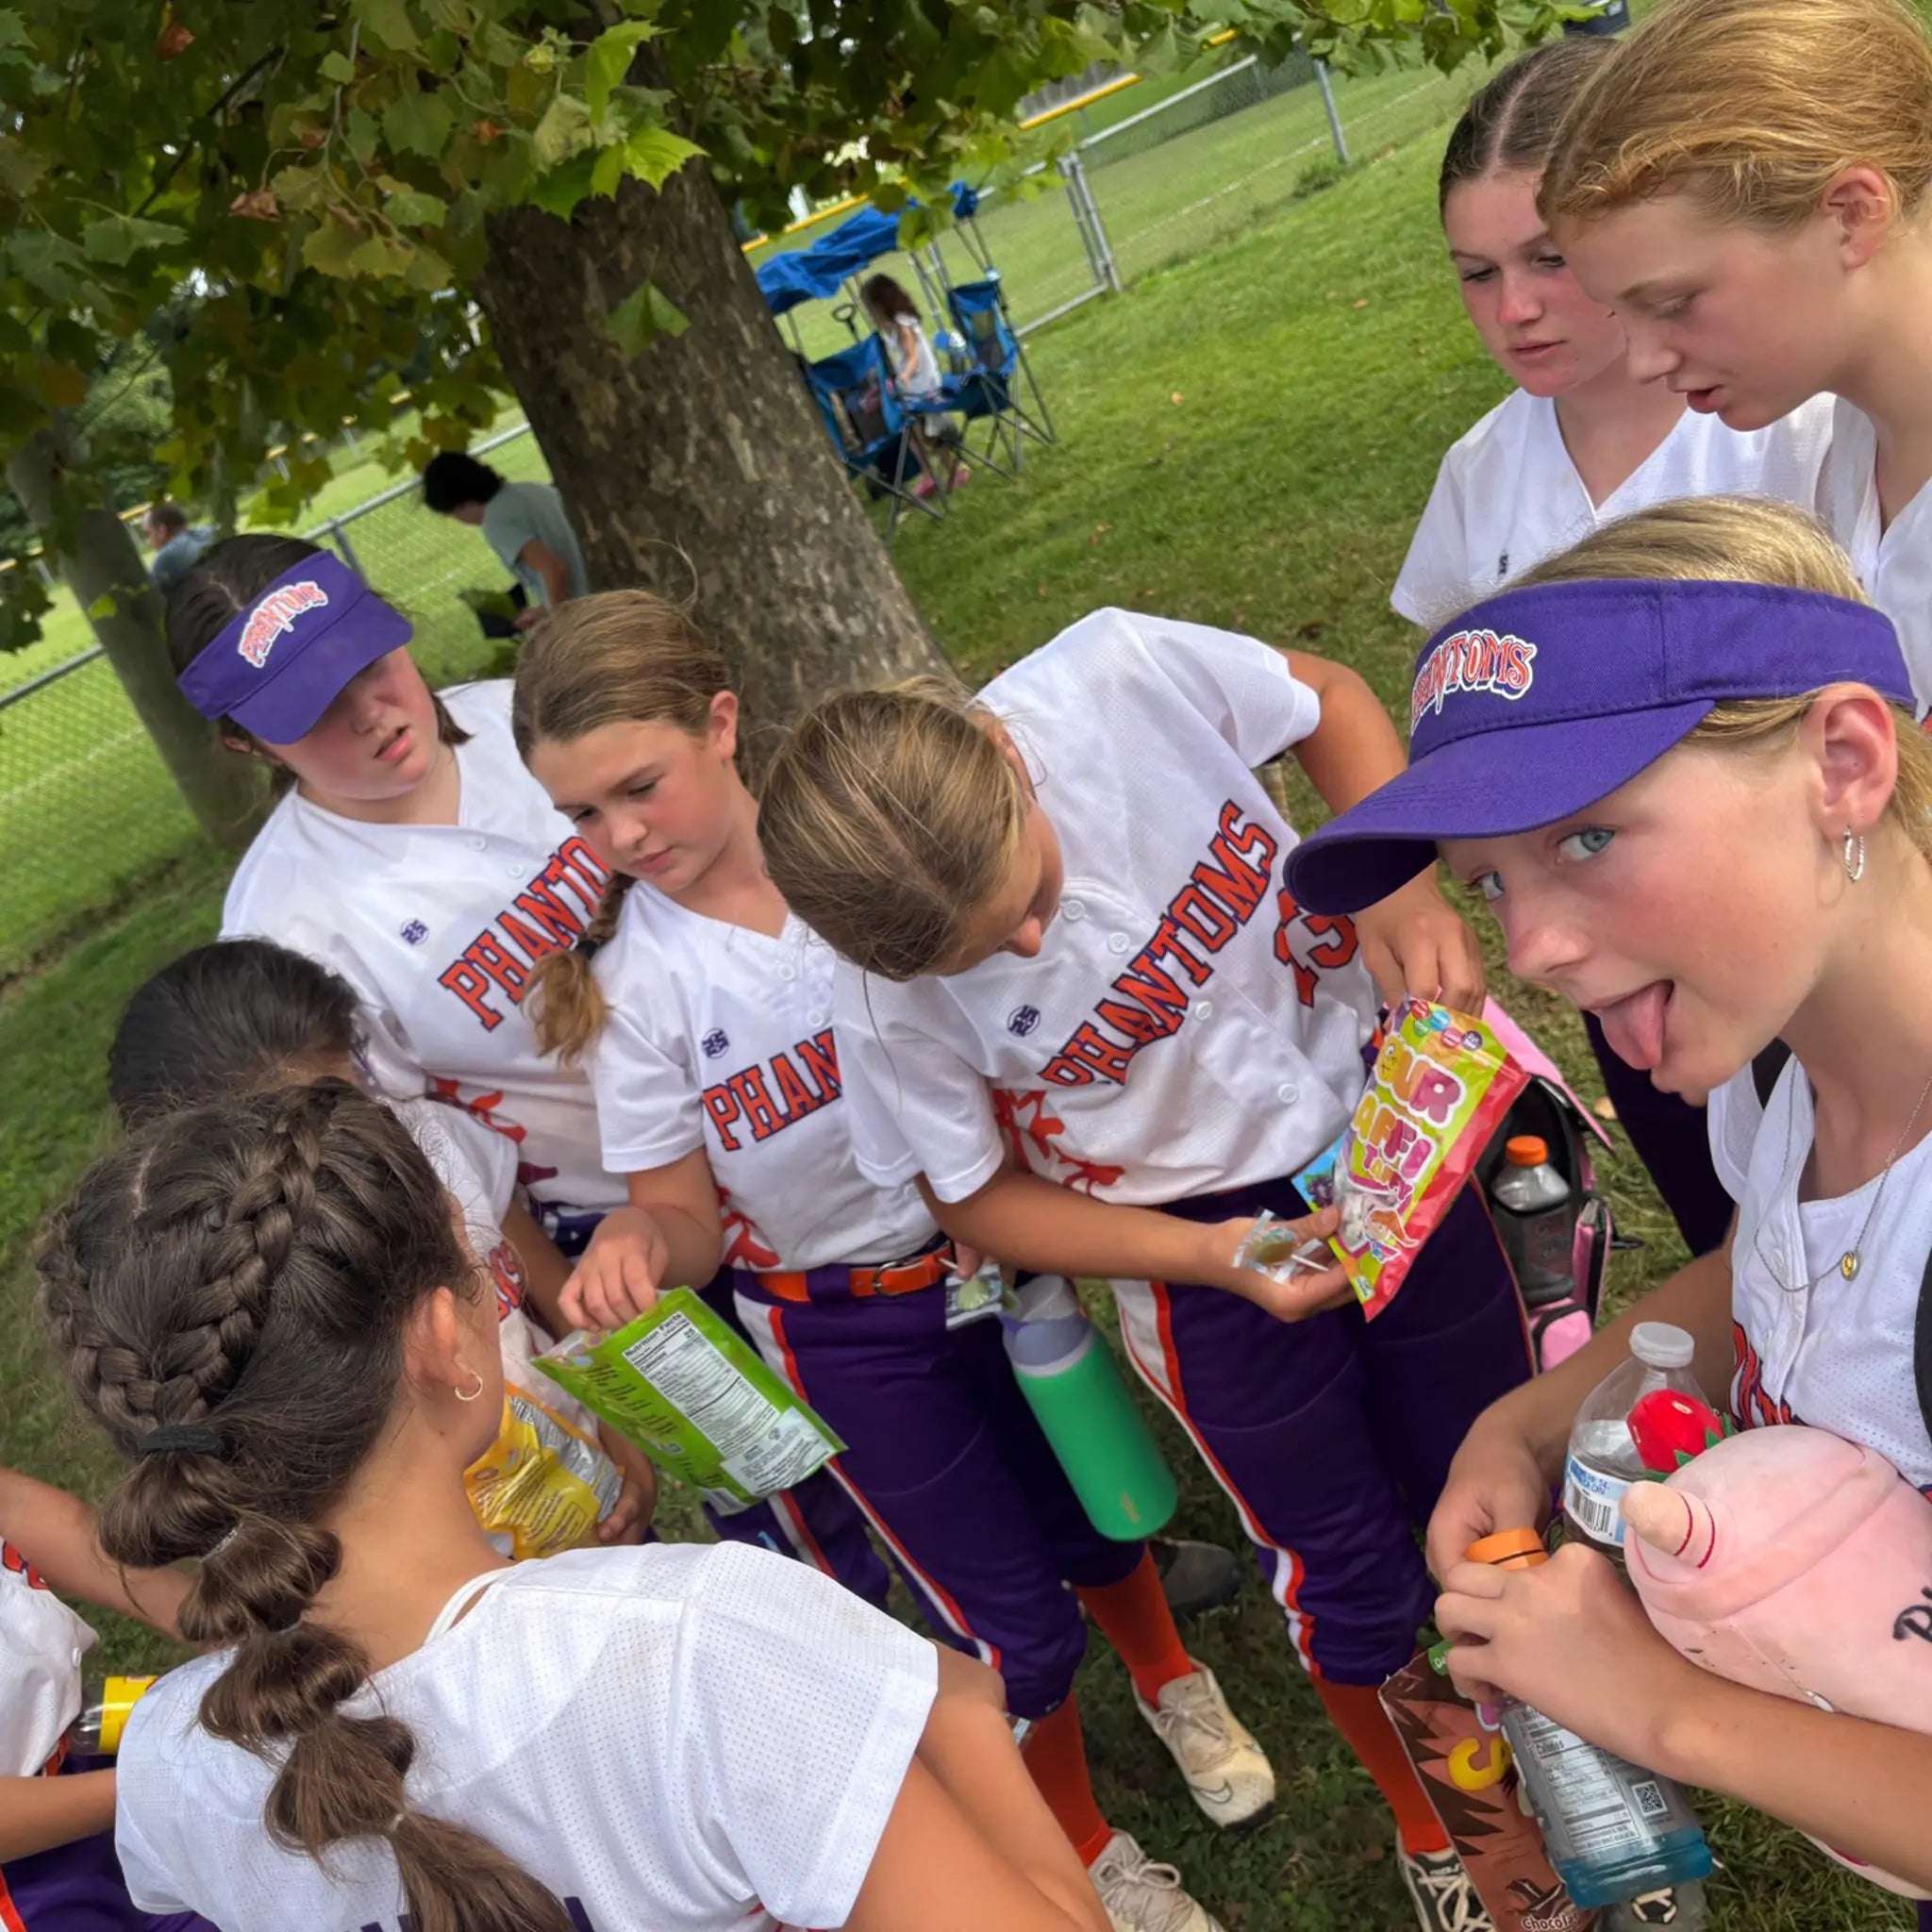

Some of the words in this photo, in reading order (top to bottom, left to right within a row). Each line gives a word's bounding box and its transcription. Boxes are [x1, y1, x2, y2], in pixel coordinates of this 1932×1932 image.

[1411, 629, 1537, 733] ANTOMS
[1039, 798, 1278, 1086] PHANTOMS
[702, 1026, 843, 1152] PHAN
